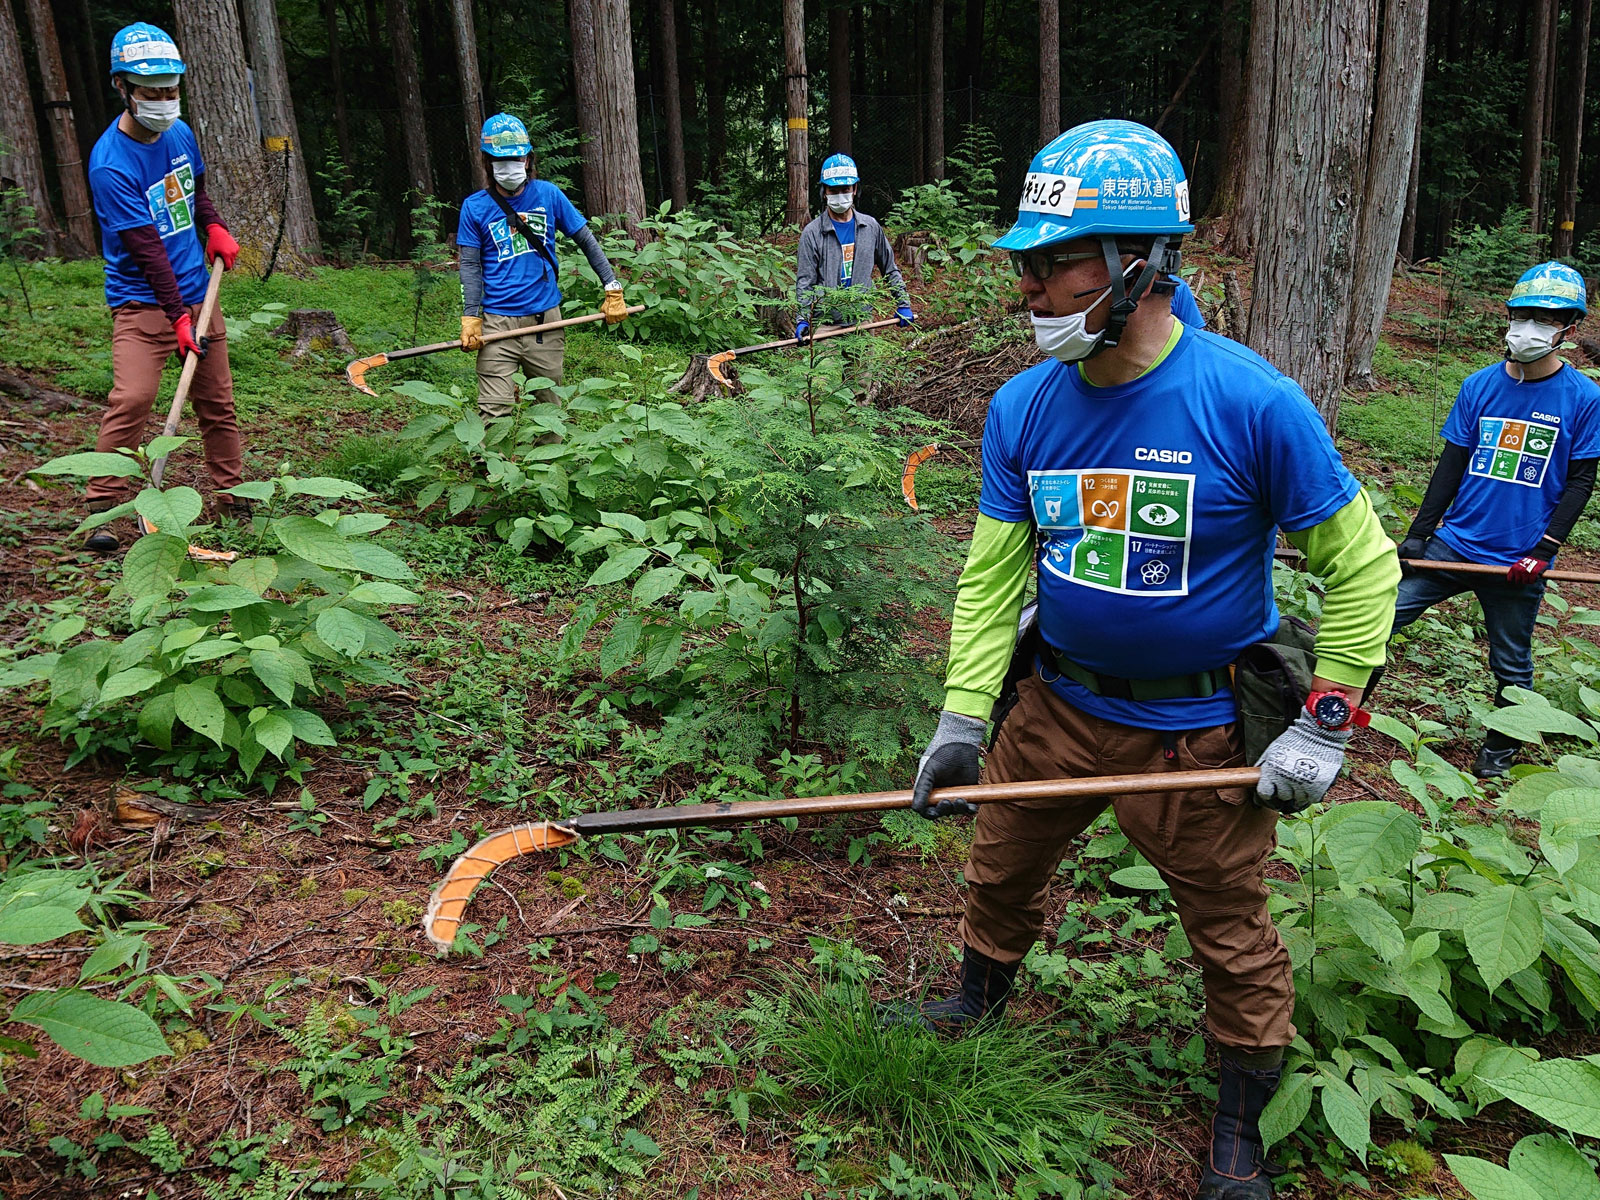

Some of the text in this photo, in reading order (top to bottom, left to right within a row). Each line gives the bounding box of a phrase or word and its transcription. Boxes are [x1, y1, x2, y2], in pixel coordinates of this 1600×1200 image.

[1103, 177, 1172, 198] 東京都水道局
[1531, 411, 1561, 424] CASIO
[1134, 447, 1193, 464] CASIO
[1083, 478, 1096, 490] 12
[1135, 480, 1147, 493] 13
[1131, 540, 1143, 552] 17
